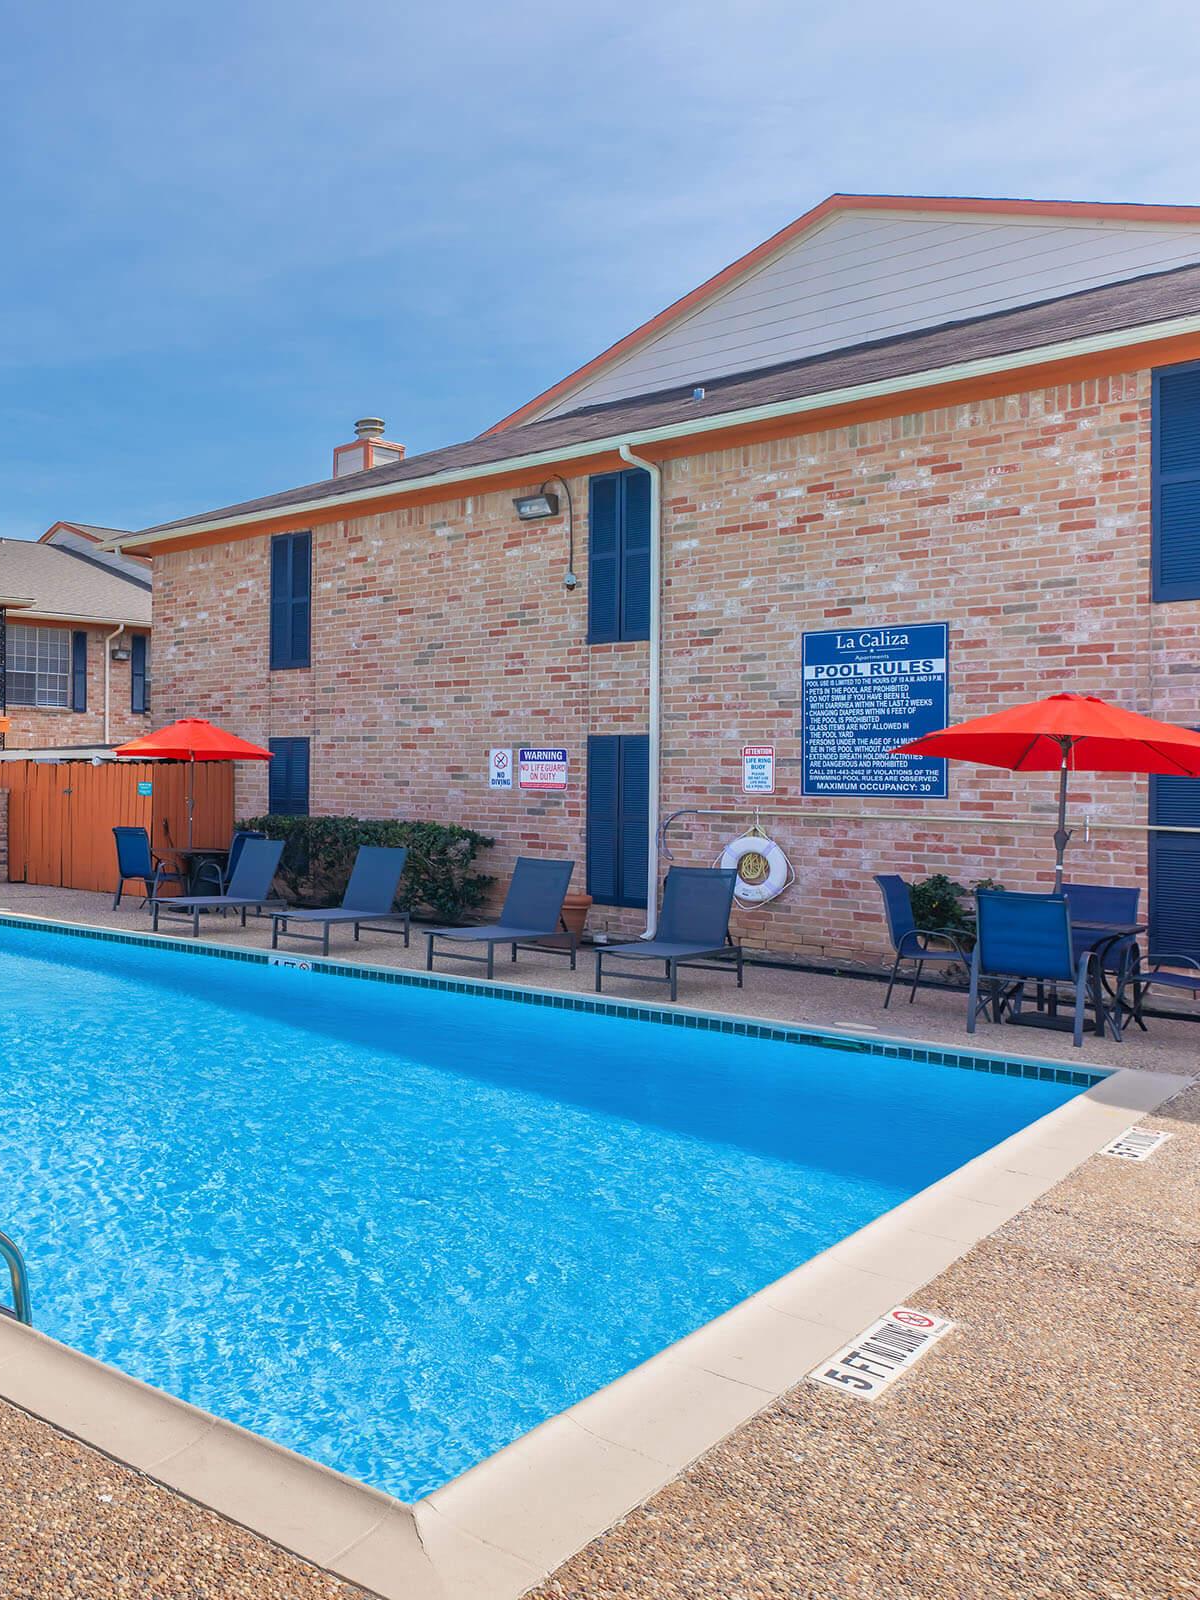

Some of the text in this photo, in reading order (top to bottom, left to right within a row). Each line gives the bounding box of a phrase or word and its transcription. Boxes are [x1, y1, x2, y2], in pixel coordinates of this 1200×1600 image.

[836, 631, 909, 649] La Caliza
[814, 660, 934, 678] POOL RULES
[873, 684, 909, 693] PROHIBITED
[831, 694, 846, 702] SWIM
[853, 693, 865, 701] YOU
[866, 693, 882, 701] HAVE
[883, 692, 900, 700] BEEN
[810, 702, 824, 710] WITH
[825, 701, 854, 709] DIARRHEA
[854, 700, 875, 708] WITHIN
[888, 699, 904, 707] LAST
[910, 698, 933, 706] WEEKS
[839, 708, 864, 716] DIAPERS
[891, 707, 907, 715] FEET
[907, 706, 917, 714] OF
[822, 716, 837, 724] POOL
[845, 715, 880, 723] PROHIBITED
[872, 722, 901, 730] ALLOWED
[809, 738, 835, 746] PERSONS
[869, 737, 882, 745] AGE
[882, 737, 892, 745] OF
[893, 737, 900, 745] 14
[810, 745, 818, 753] BE
[818, 745, 825, 753] IN
[825, 745, 837, 753] THE
[837, 745, 853, 753] POOL
[854, 745, 881, 753] WITHOUT
[524, 751, 563, 761] WARNING
[531, 764, 565, 772] LIFEGUARD
[822, 760, 858, 768] DANGEROUS
[858, 760, 871, 768] AND
[872, 760, 908, 768] PROHIBITED
[530, 772, 539, 780] ON
[816, 782, 857, 790] MAXIMUM
[919, 783, 931, 791] 30
[869, 1323, 929, 1353] DIVING
[858, 1341, 908, 1363] NO
[840, 1350, 895, 1379] FT
[824, 1368, 873, 1391] 5
